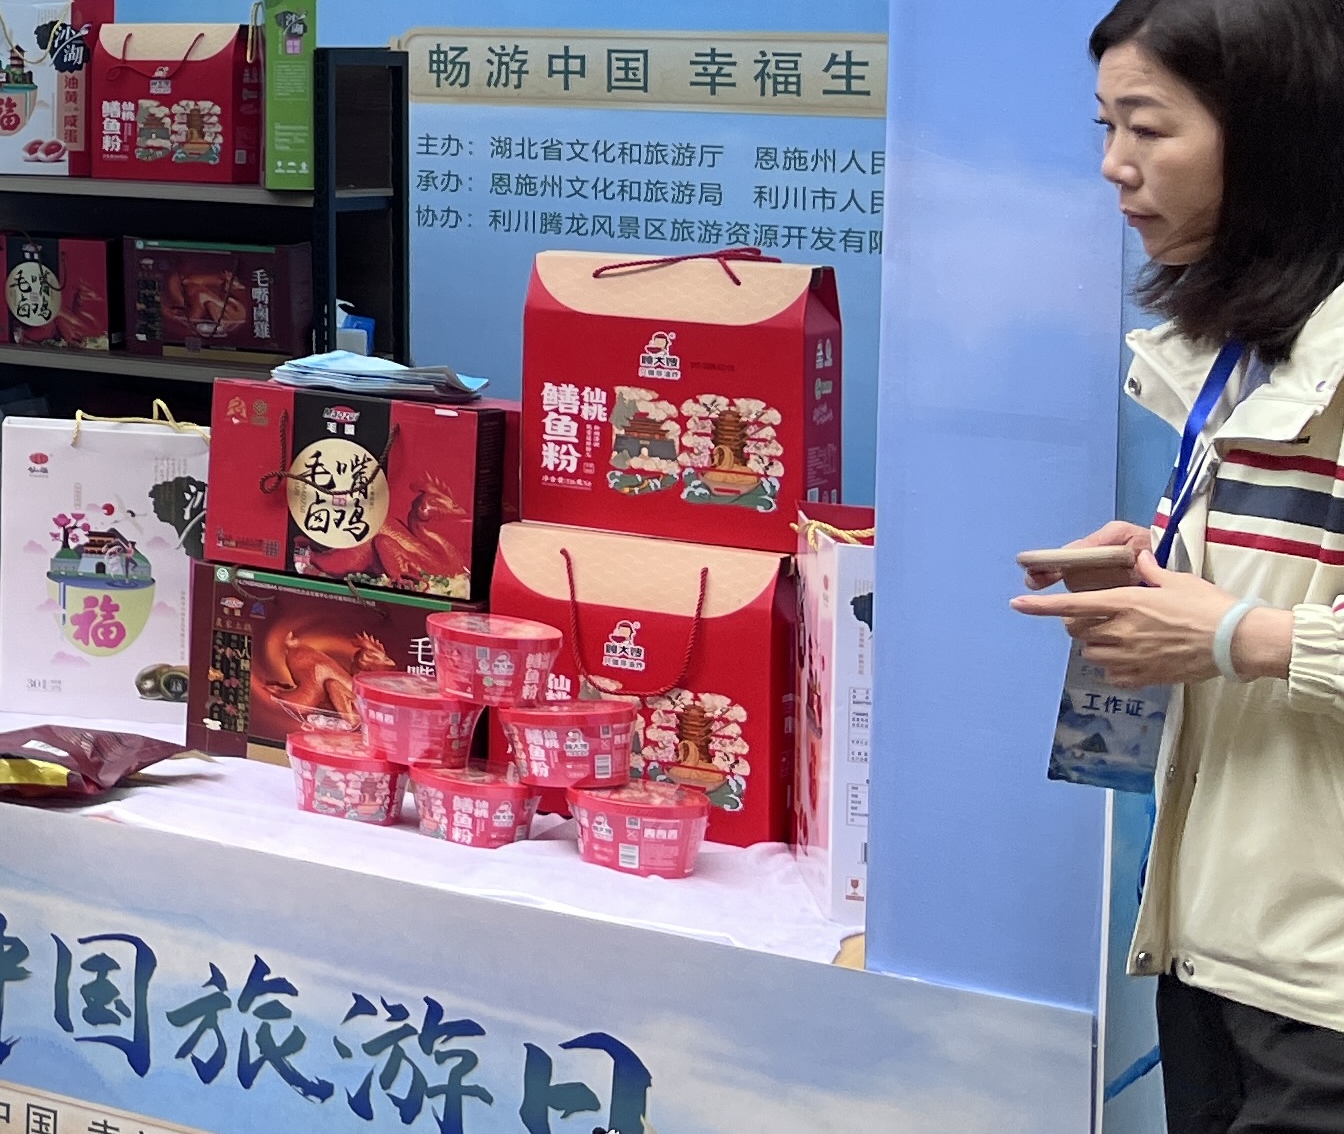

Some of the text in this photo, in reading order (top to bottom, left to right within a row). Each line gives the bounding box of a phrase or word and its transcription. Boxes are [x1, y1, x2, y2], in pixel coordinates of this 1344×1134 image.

[428, 43, 872, 98] 畅游中国 幸福生
[540, 381, 582, 474] 鳝鱼粉
[580, 386, 608, 423] 仙桃
[304, 491, 370, 542] 卤鸡
[70, 594, 127, 649] 福
[1081, 693, 1146, 717] 工作证
